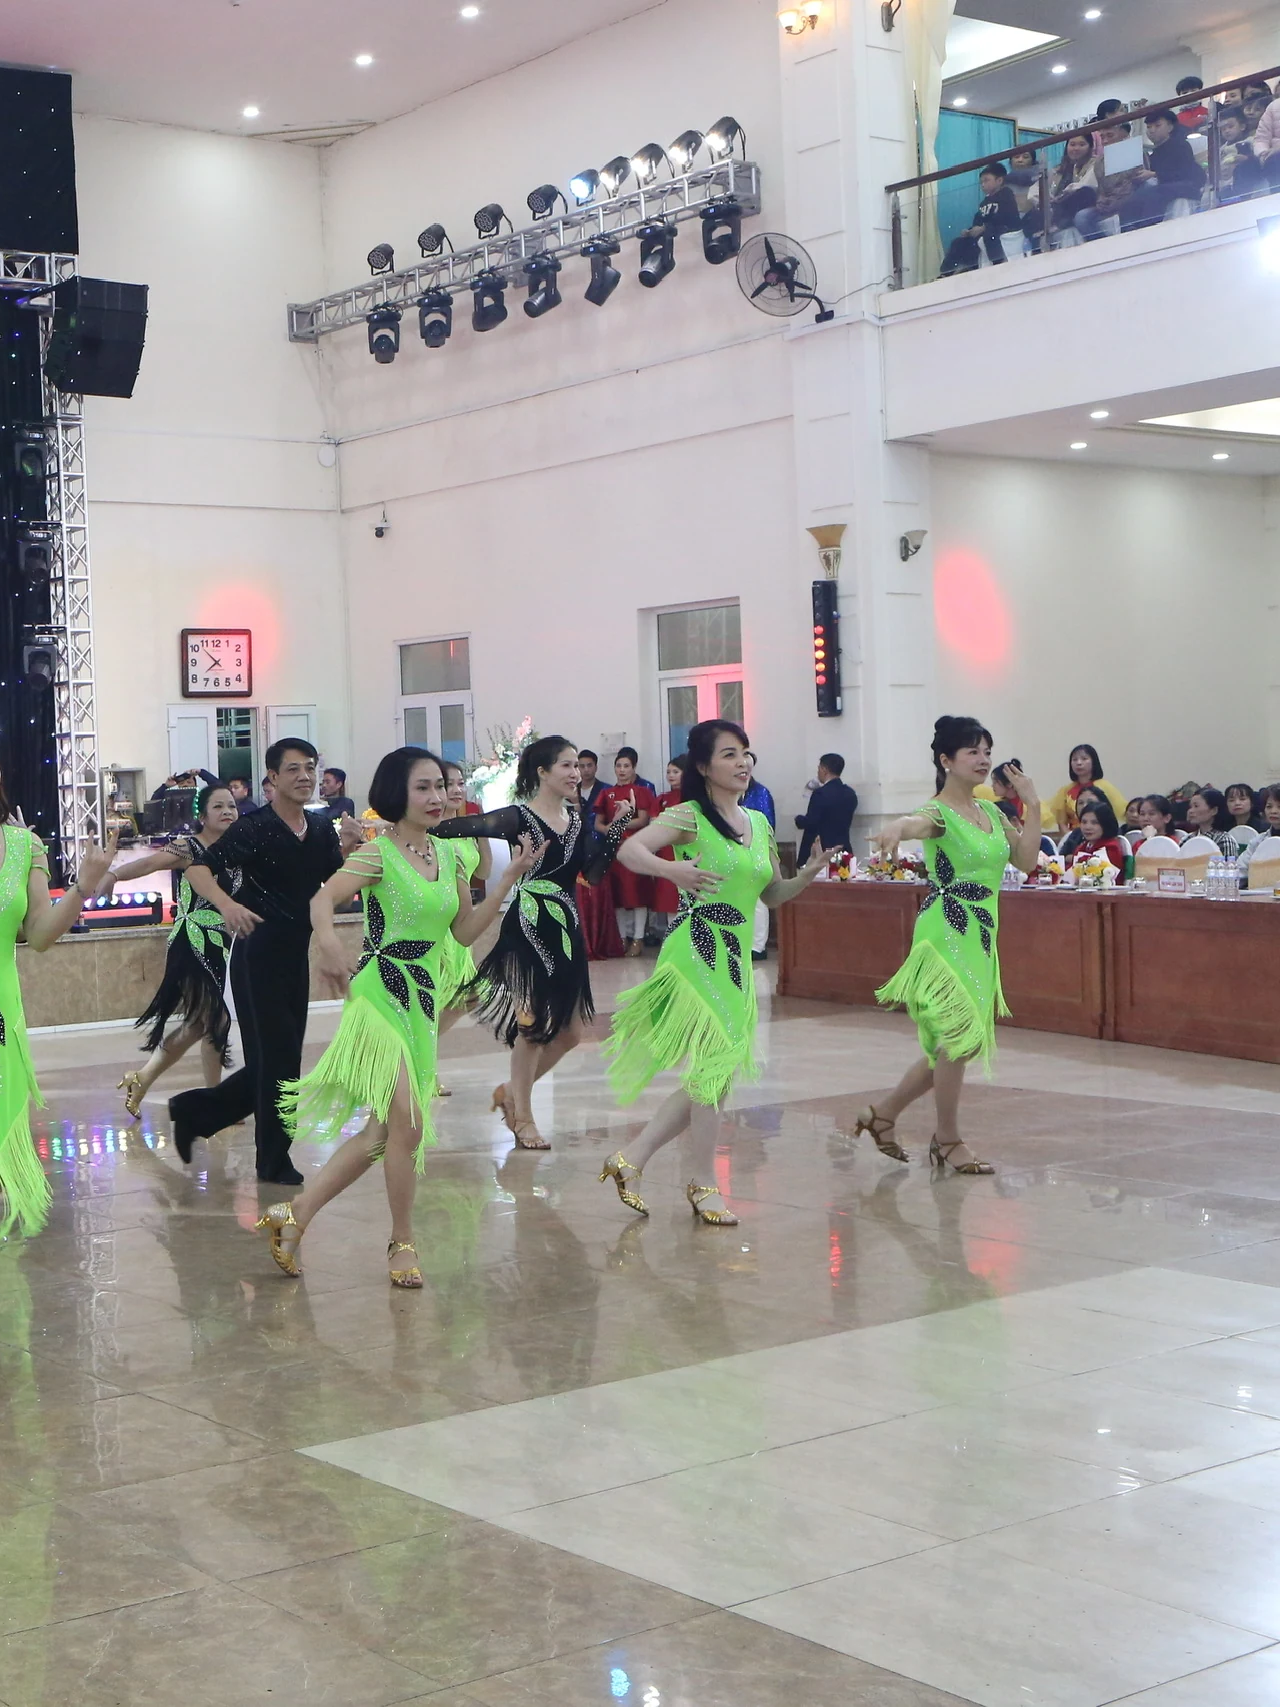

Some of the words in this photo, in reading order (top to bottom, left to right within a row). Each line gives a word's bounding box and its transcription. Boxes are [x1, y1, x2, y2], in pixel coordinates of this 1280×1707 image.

[979, 203, 999, 217] 977
[190, 644, 199, 652] 10
[225, 640, 229, 648] 1
[235, 644, 241, 653] 2
[191, 659, 197, 667] 9
[236, 659, 241, 667] 3
[192, 674, 197, 683] 8
[203, 677, 209, 687] 7
[214, 678, 220, 687] 6
[225, 677, 231, 687] 5
[235, 674, 241, 683] 4
